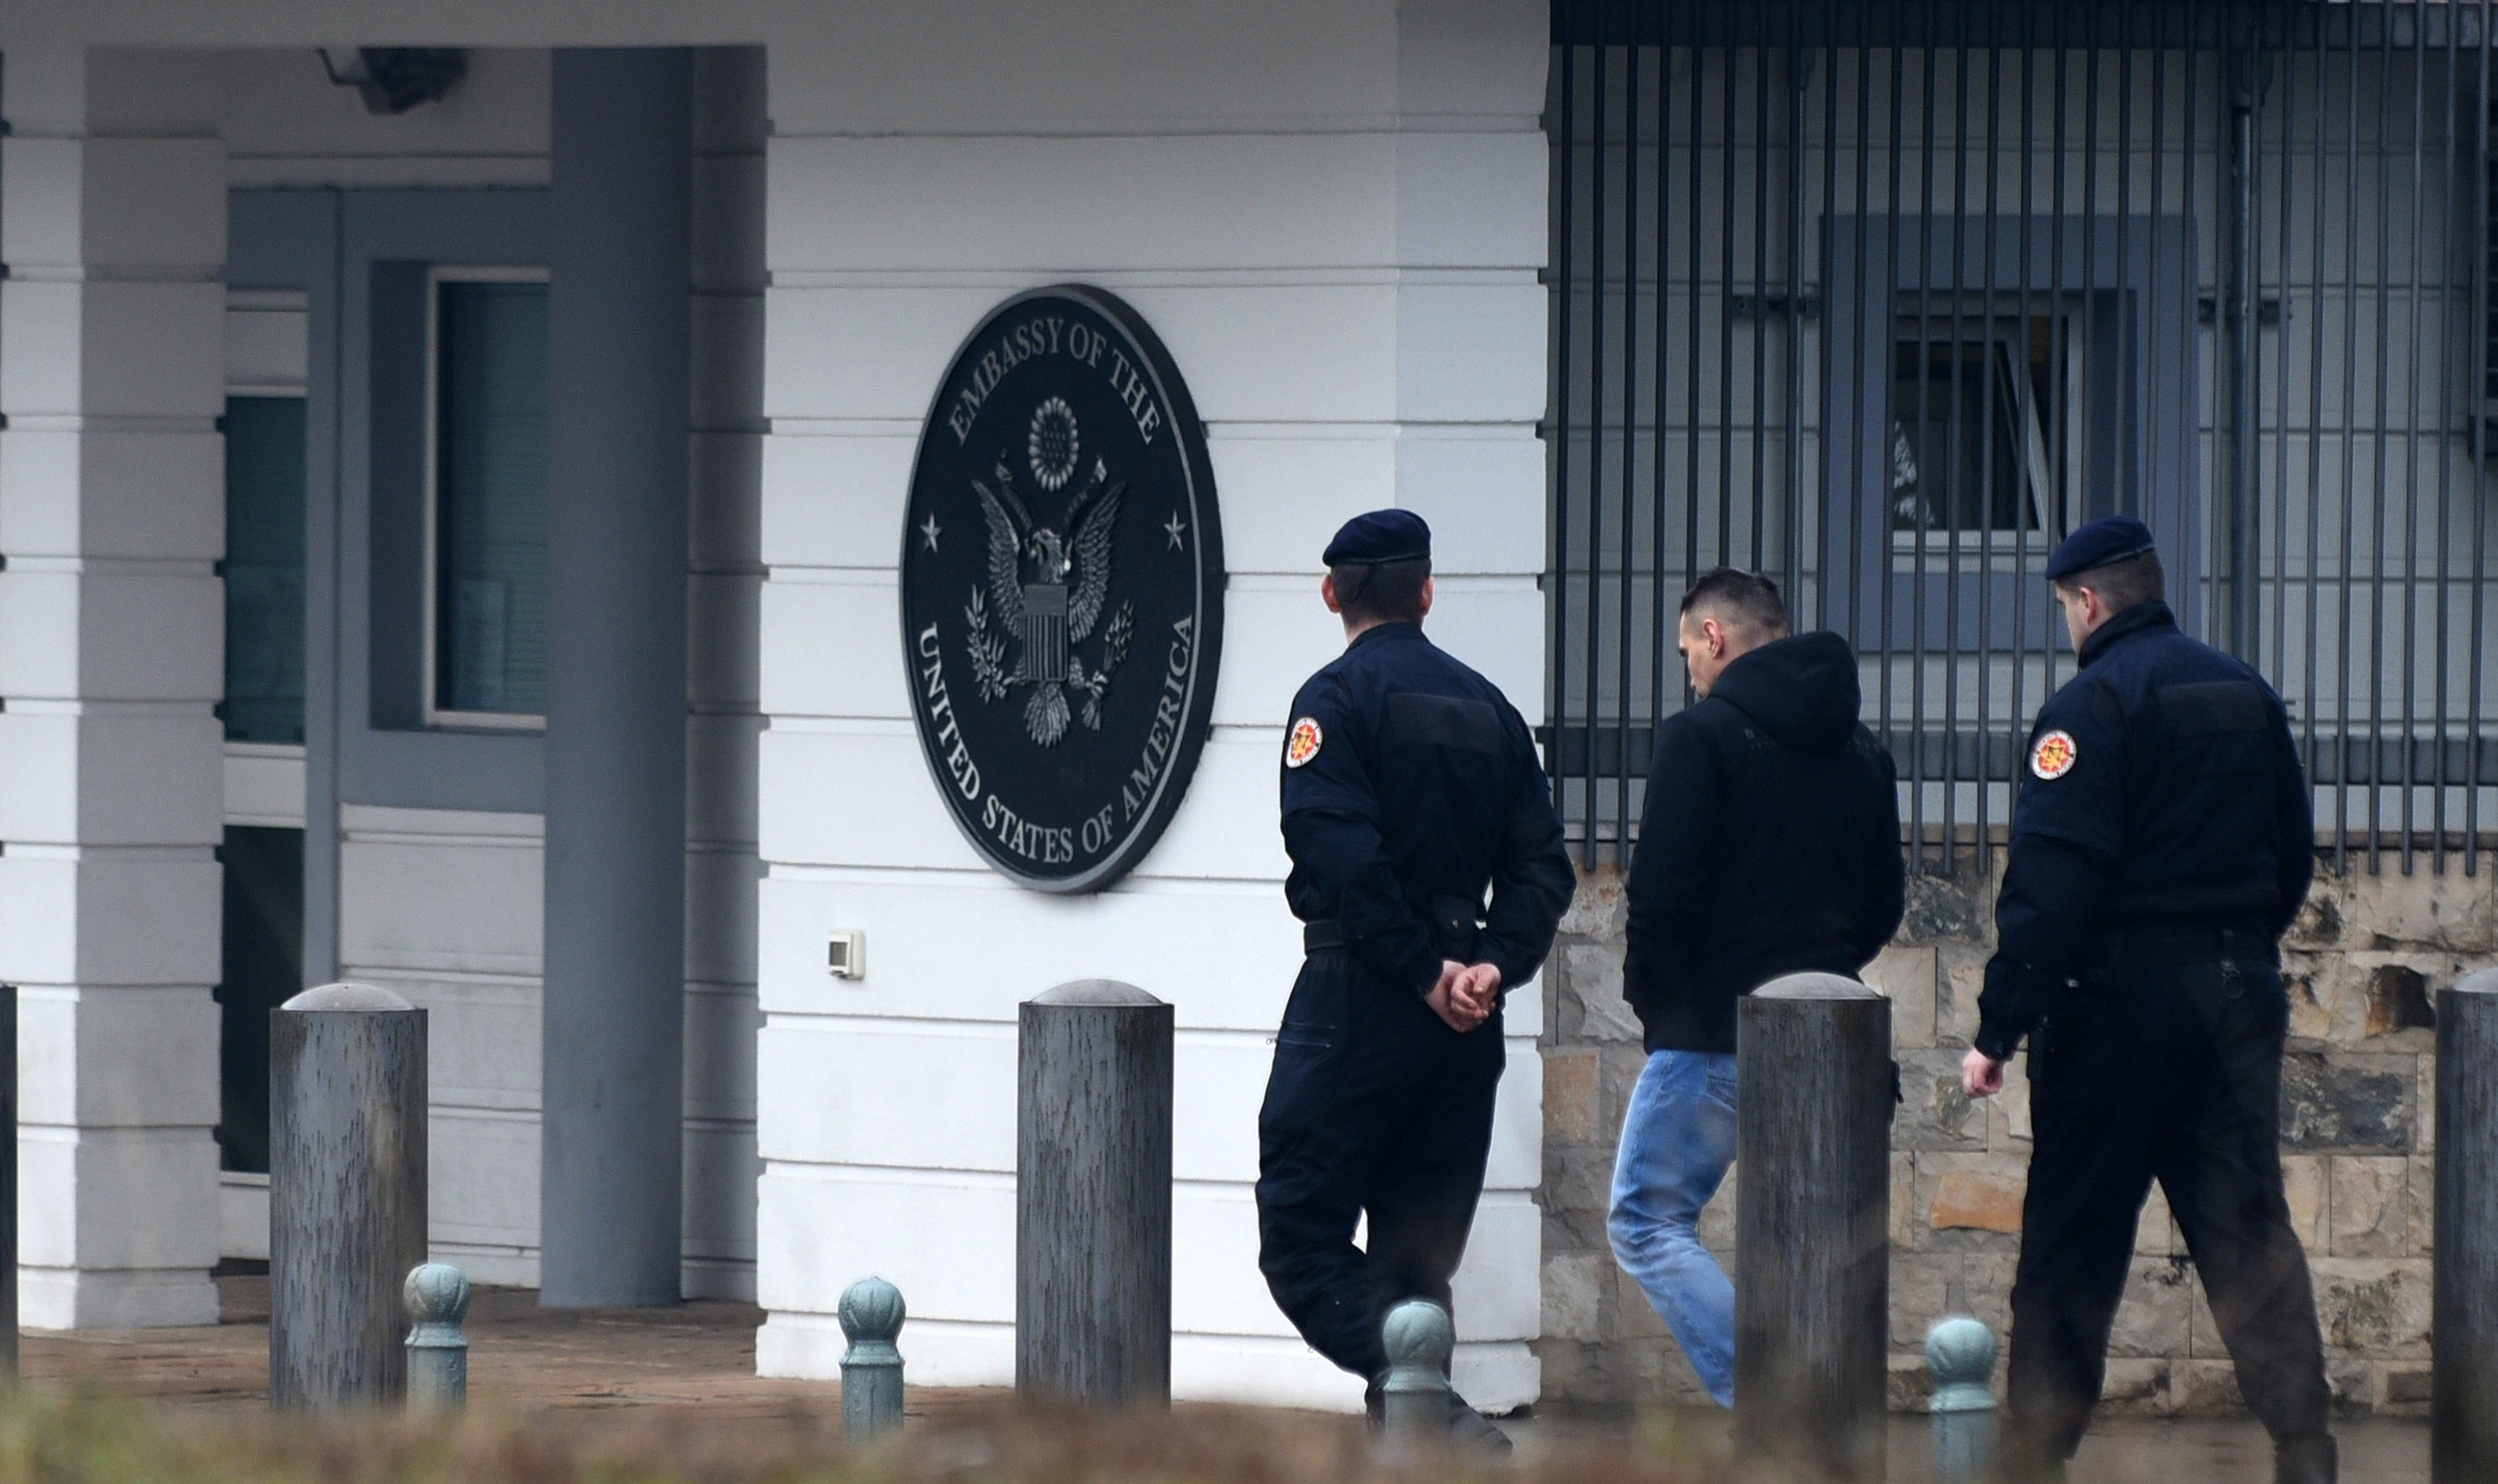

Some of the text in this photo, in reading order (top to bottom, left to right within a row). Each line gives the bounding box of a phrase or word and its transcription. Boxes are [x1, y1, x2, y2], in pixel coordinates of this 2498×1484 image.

[948, 318, 1160, 446] EMBASSY OF THE
[920, 622, 980, 800] UNITED
[982, 794, 1074, 863] STATES
[1082, 804, 1113, 853] OF
[1123, 614, 1192, 822] AMERICA
